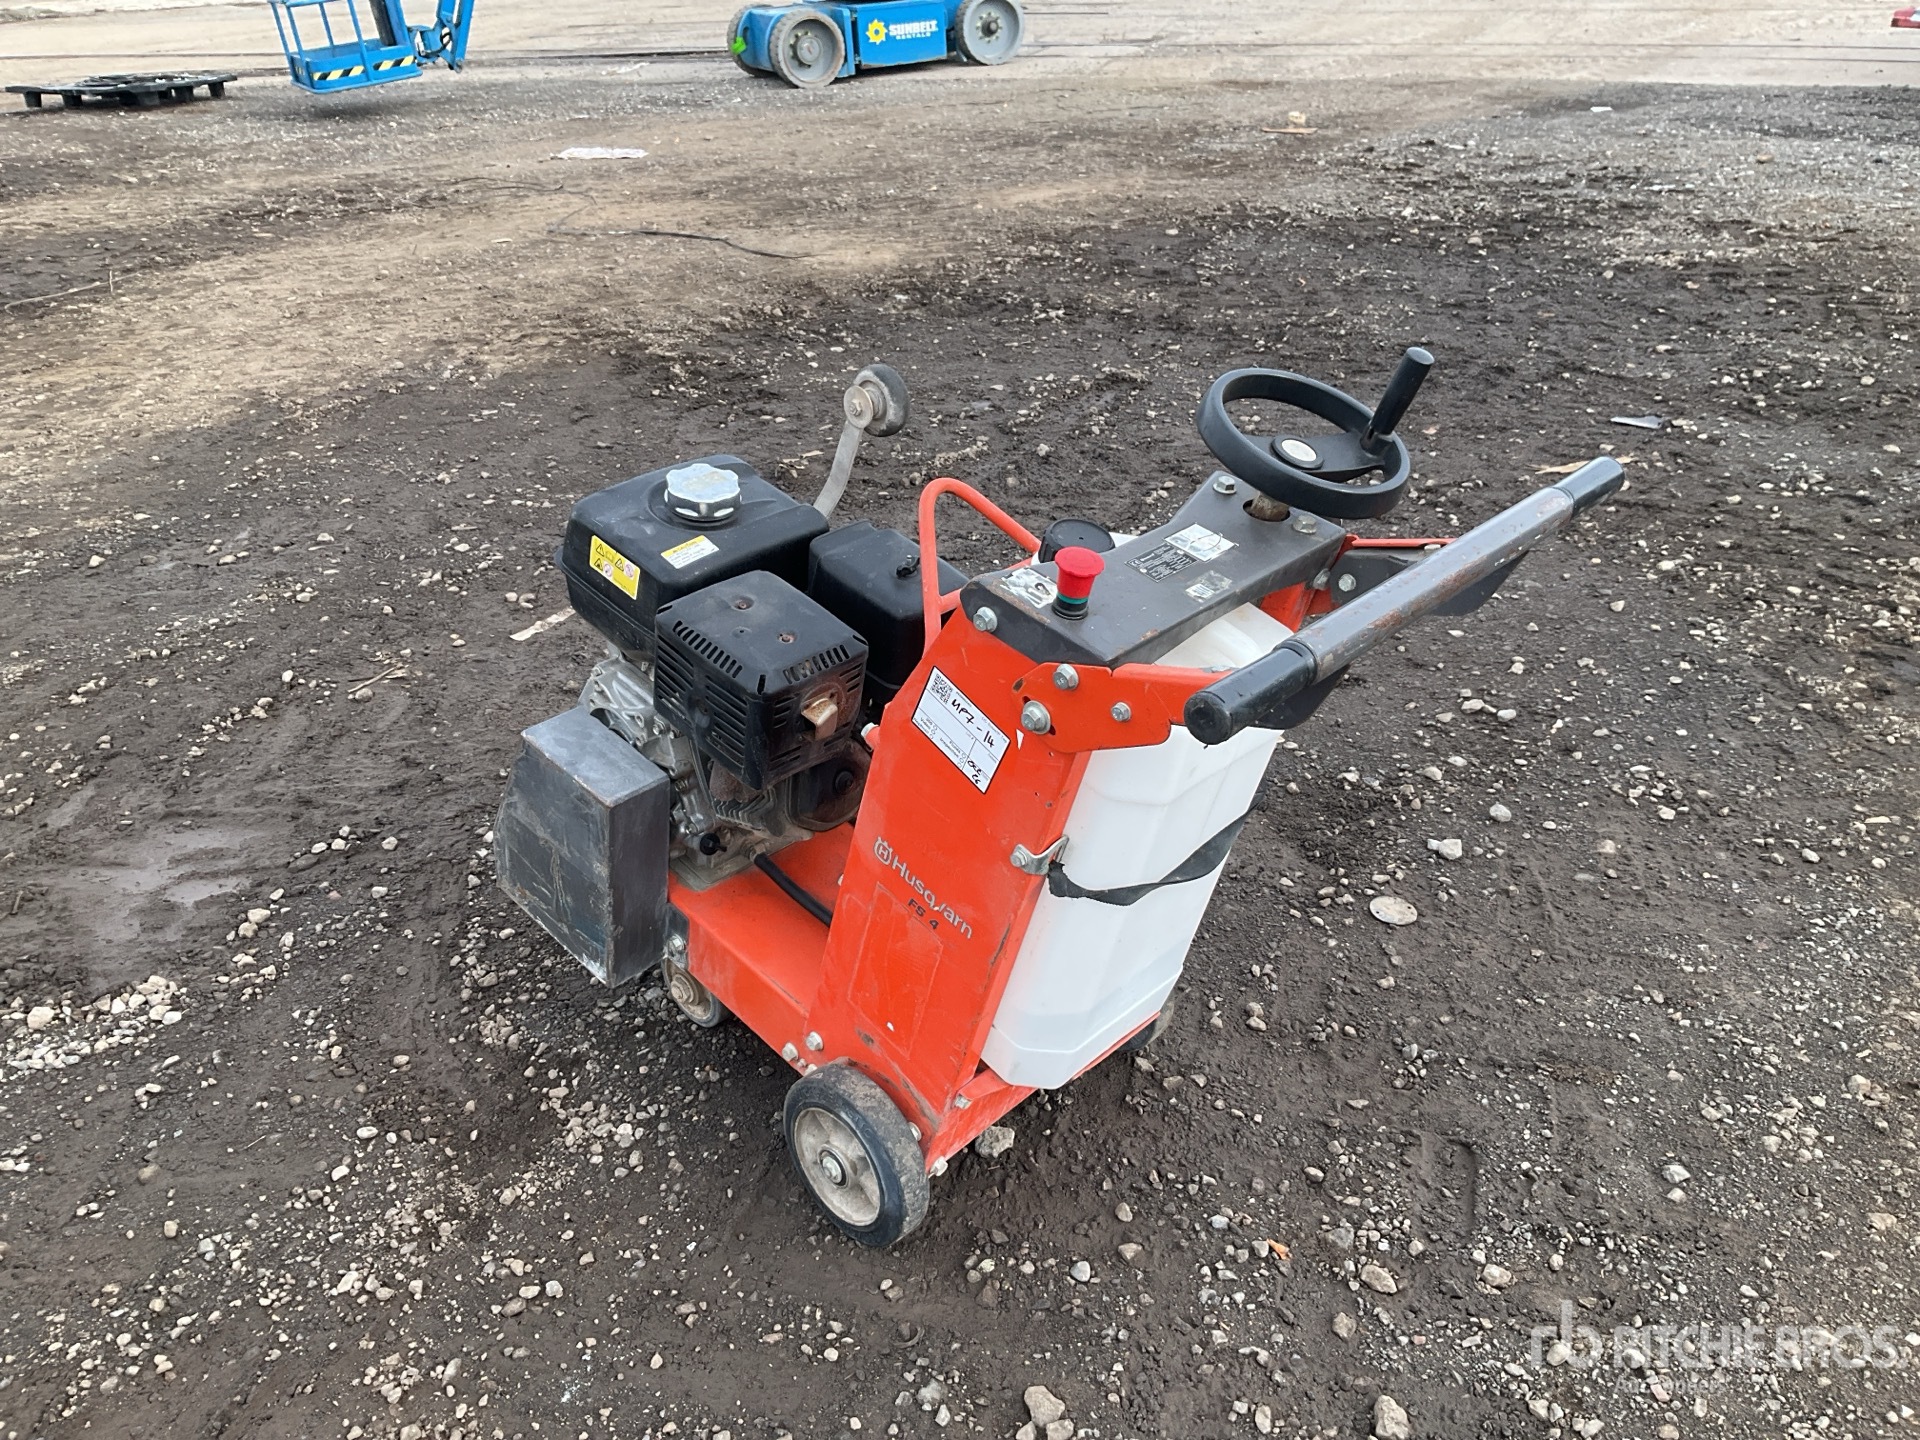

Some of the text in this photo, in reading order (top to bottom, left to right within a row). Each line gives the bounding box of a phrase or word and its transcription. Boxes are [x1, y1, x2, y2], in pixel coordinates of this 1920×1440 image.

[889, 20, 938, 36] SUNBELT
[908, 898, 939, 930] FS 4
